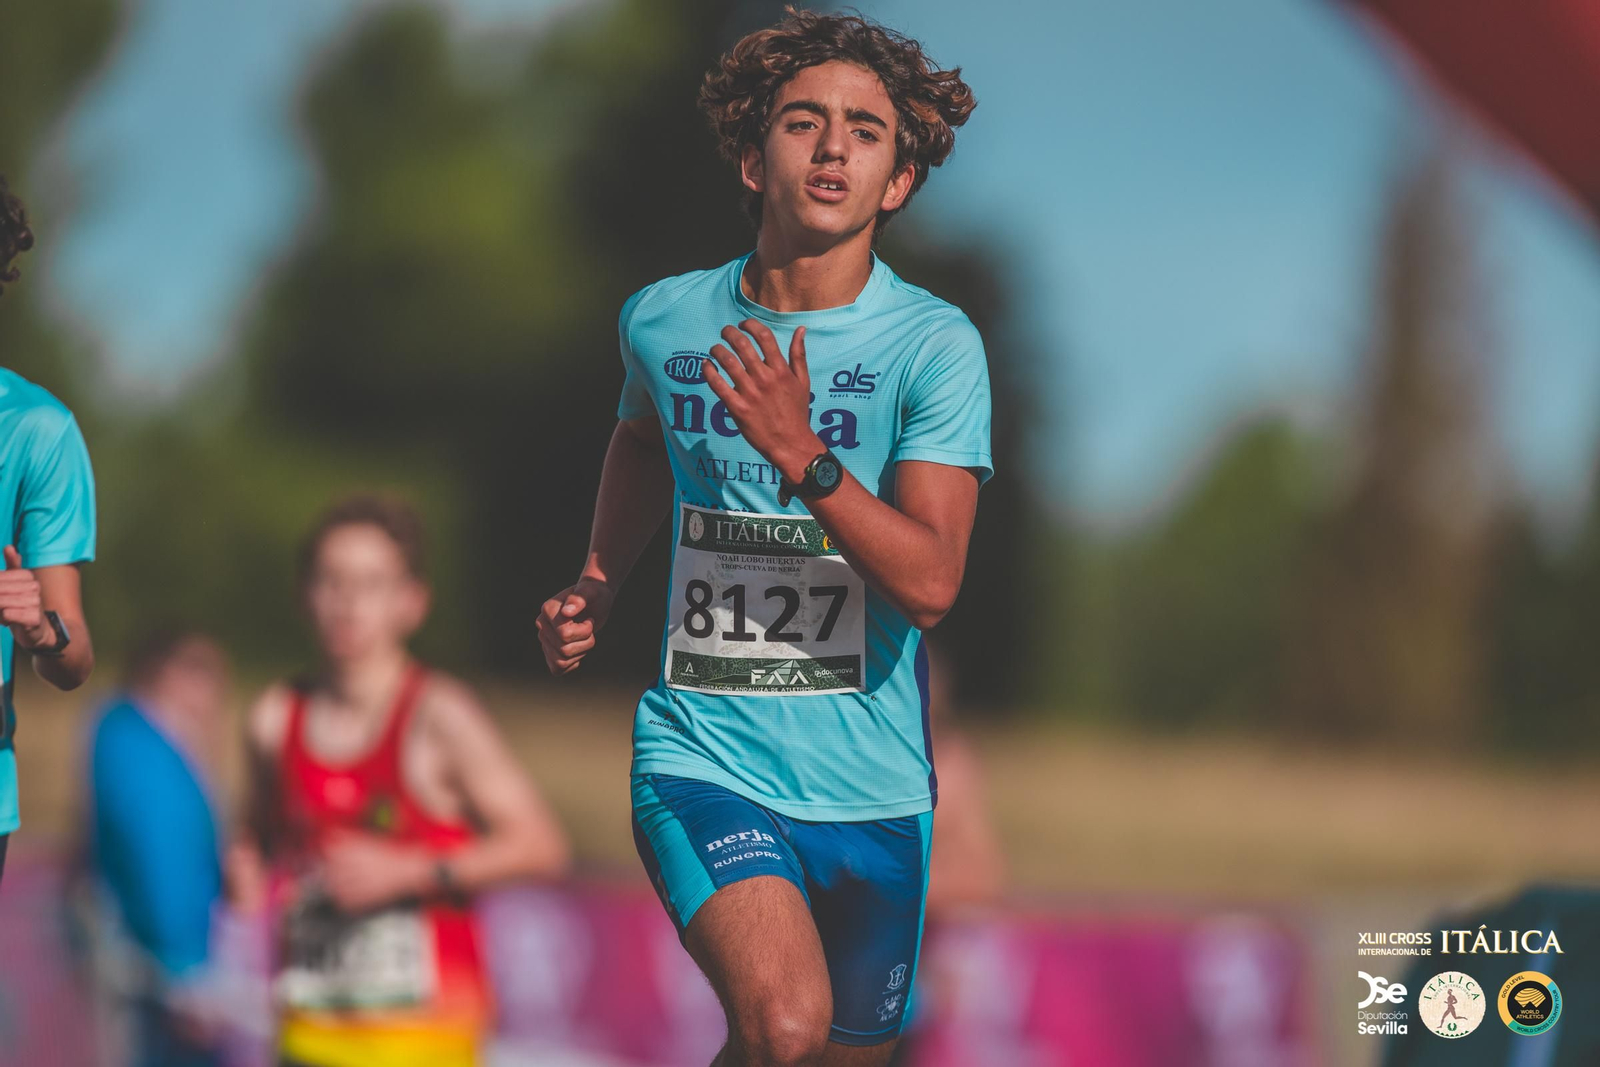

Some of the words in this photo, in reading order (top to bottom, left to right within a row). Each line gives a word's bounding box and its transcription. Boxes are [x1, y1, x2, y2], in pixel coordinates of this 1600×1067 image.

[667, 358, 702, 379] TRO
[670, 391, 861, 450] nea
[695, 455, 779, 485] ATLETI
[715, 518, 809, 544] ITÁLICA
[716, 554, 739, 562] NOAH
[741, 555, 765, 563] LOBO
[766, 557, 806, 565] HUERTAS
[720, 563, 767, 571] TROPS-CUEVA
[778, 565, 801, 573] NERJA
[683, 579, 849, 642] 8127
[821, 667, 854, 676] docunova
[706, 829, 776, 853] nerja
[721, 841, 772, 855] ATLETISMO
